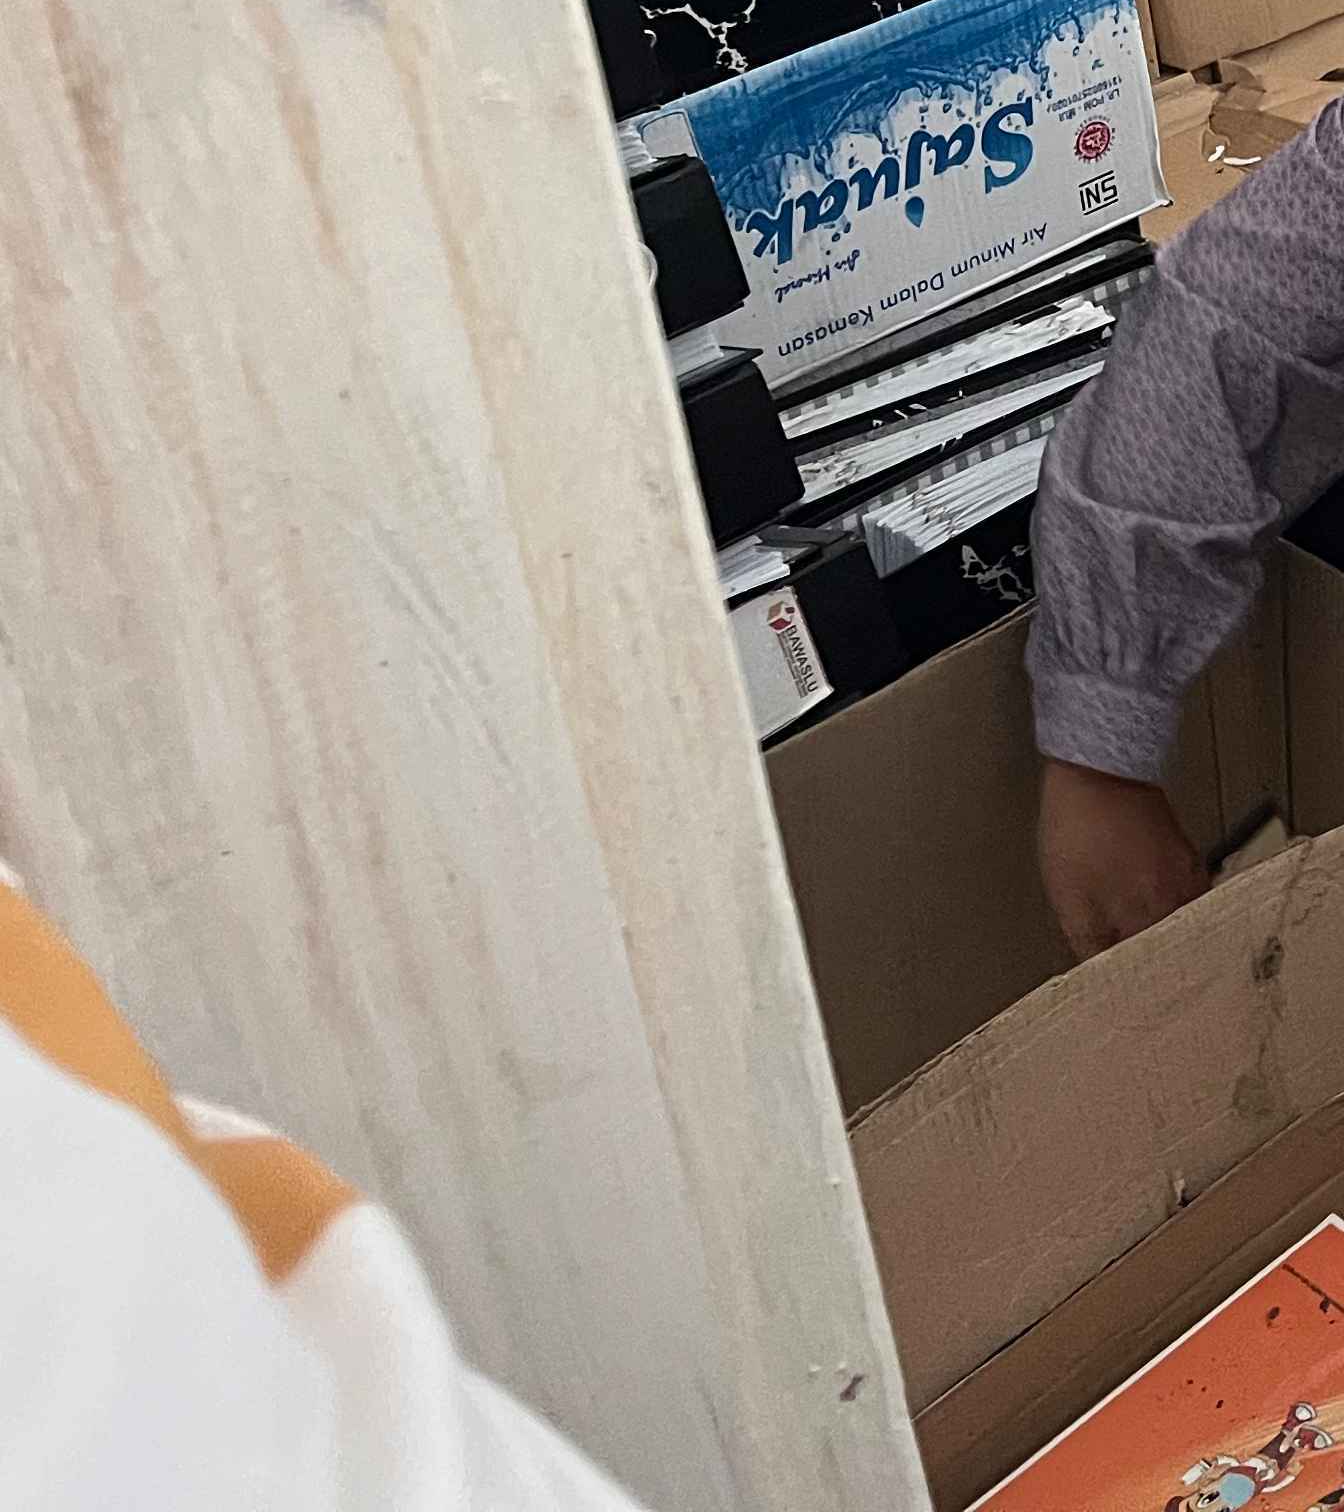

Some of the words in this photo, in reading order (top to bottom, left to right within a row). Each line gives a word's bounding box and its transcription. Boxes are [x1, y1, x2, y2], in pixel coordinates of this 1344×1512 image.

[746, 95, 1034, 266] Sajuak
[1079, 175, 1119, 212] SNI
[1023, 222, 1047, 246] Air
[951, 237, 1015, 278] Minum
[880, 271, 945, 311] Dalam
[778, 304, 874, 357] Kemasan
[786, 625, 819, 692] BAWASLU
